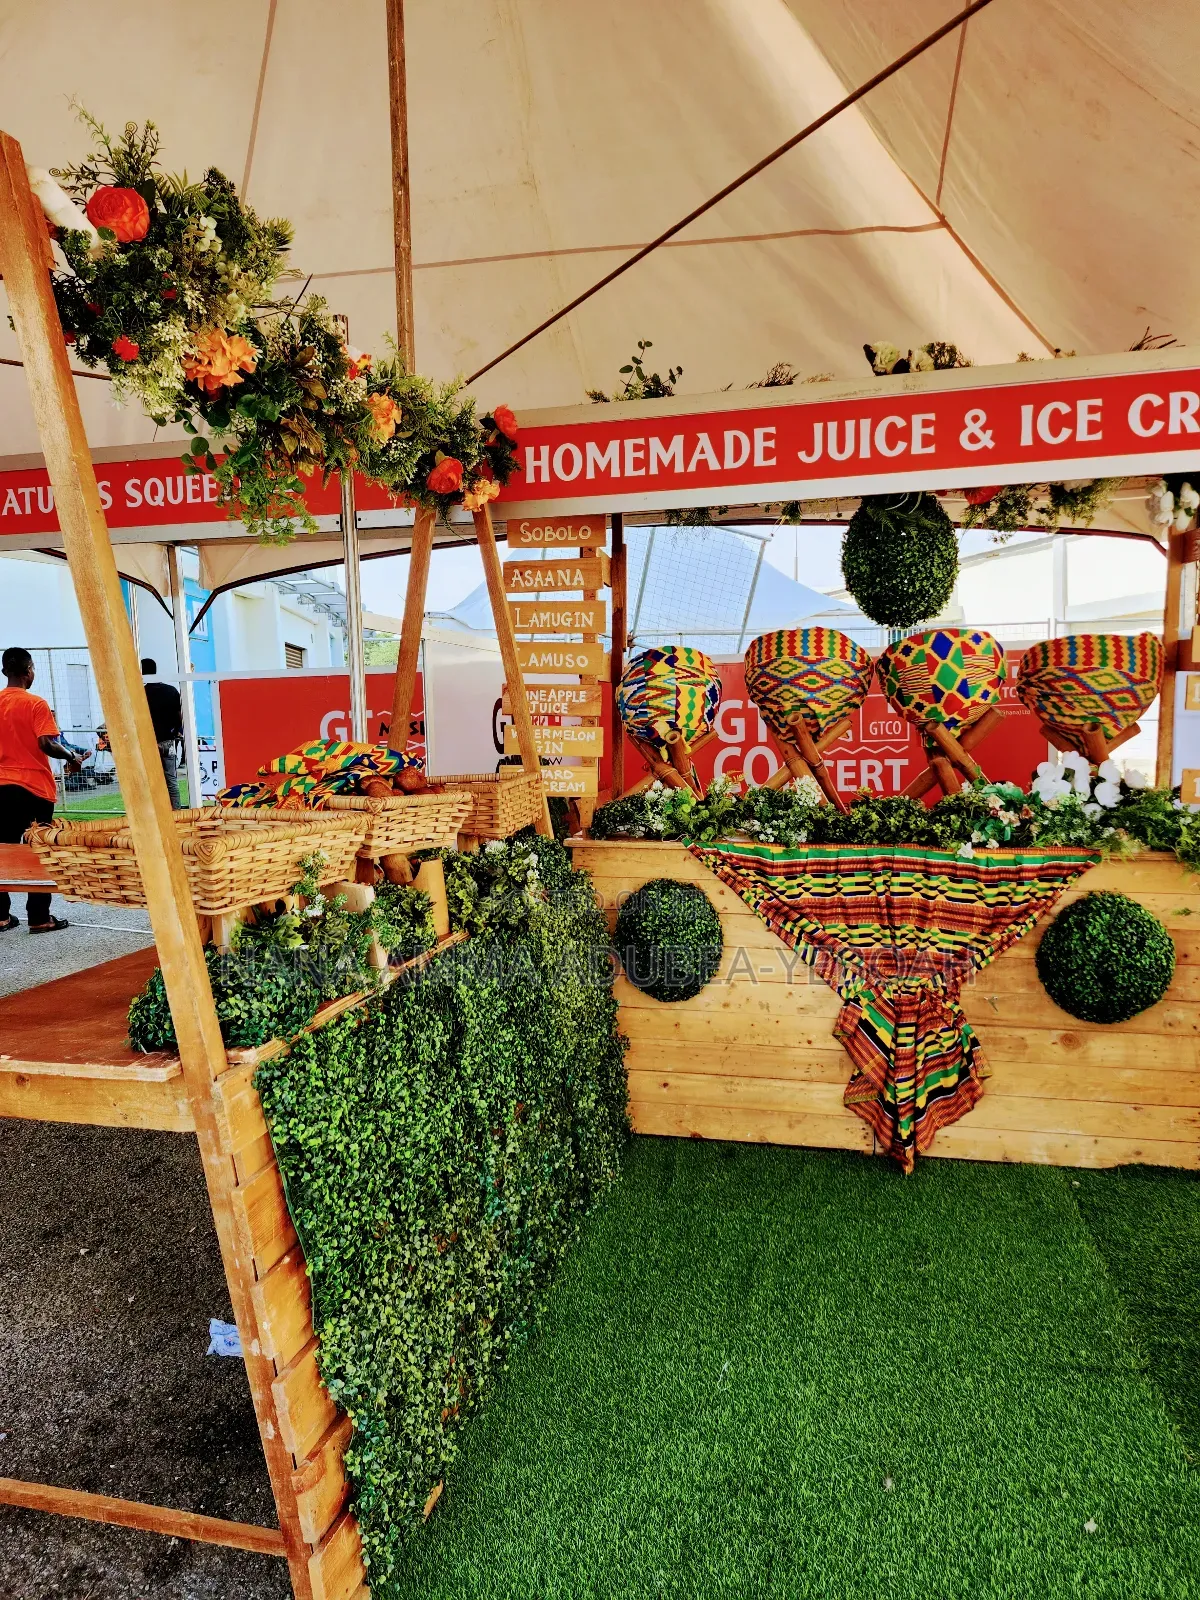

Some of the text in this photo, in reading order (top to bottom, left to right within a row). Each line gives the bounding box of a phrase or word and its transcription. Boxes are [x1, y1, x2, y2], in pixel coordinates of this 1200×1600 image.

[524, 426, 777, 484] HOMEMADE
[797, 412, 936, 464] JUICE
[959, 408, 996, 451] &
[1020, 398, 1103, 446] ICE
[124, 473, 241, 508] SQUEE
[520, 522, 592, 543] SOBOLO
[510, 568, 585, 588] ASAANA
[514, 607, 595, 628] LAMUGIN
[525, 688, 588, 703] INEAPPLE
[529, 700, 568, 714] JUICE
[869, 720, 902, 735] GTCO
[713, 745, 909, 792] COERT
